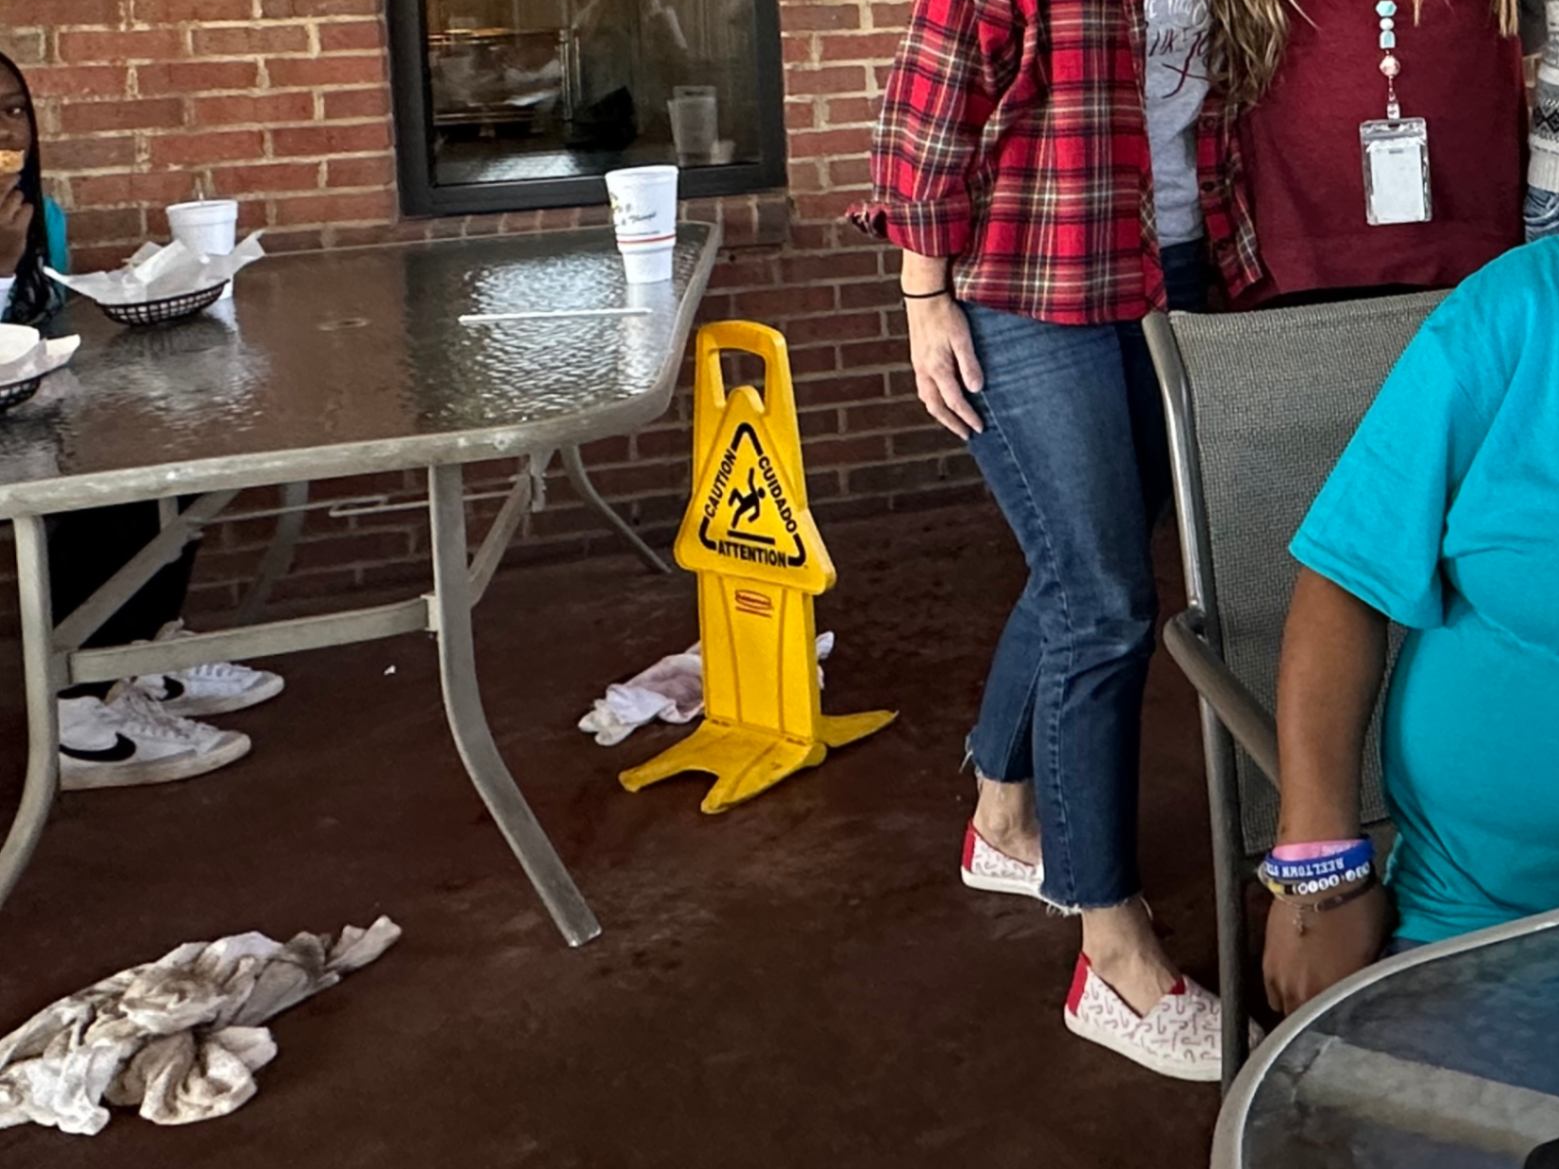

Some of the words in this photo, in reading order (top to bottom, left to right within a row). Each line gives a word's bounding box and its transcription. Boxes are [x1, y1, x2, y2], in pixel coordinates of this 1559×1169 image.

[704, 447, 738, 518] CAUTION
[758, 455, 798, 534] CUIDADO
[716, 540, 788, 569] ATTENTION
